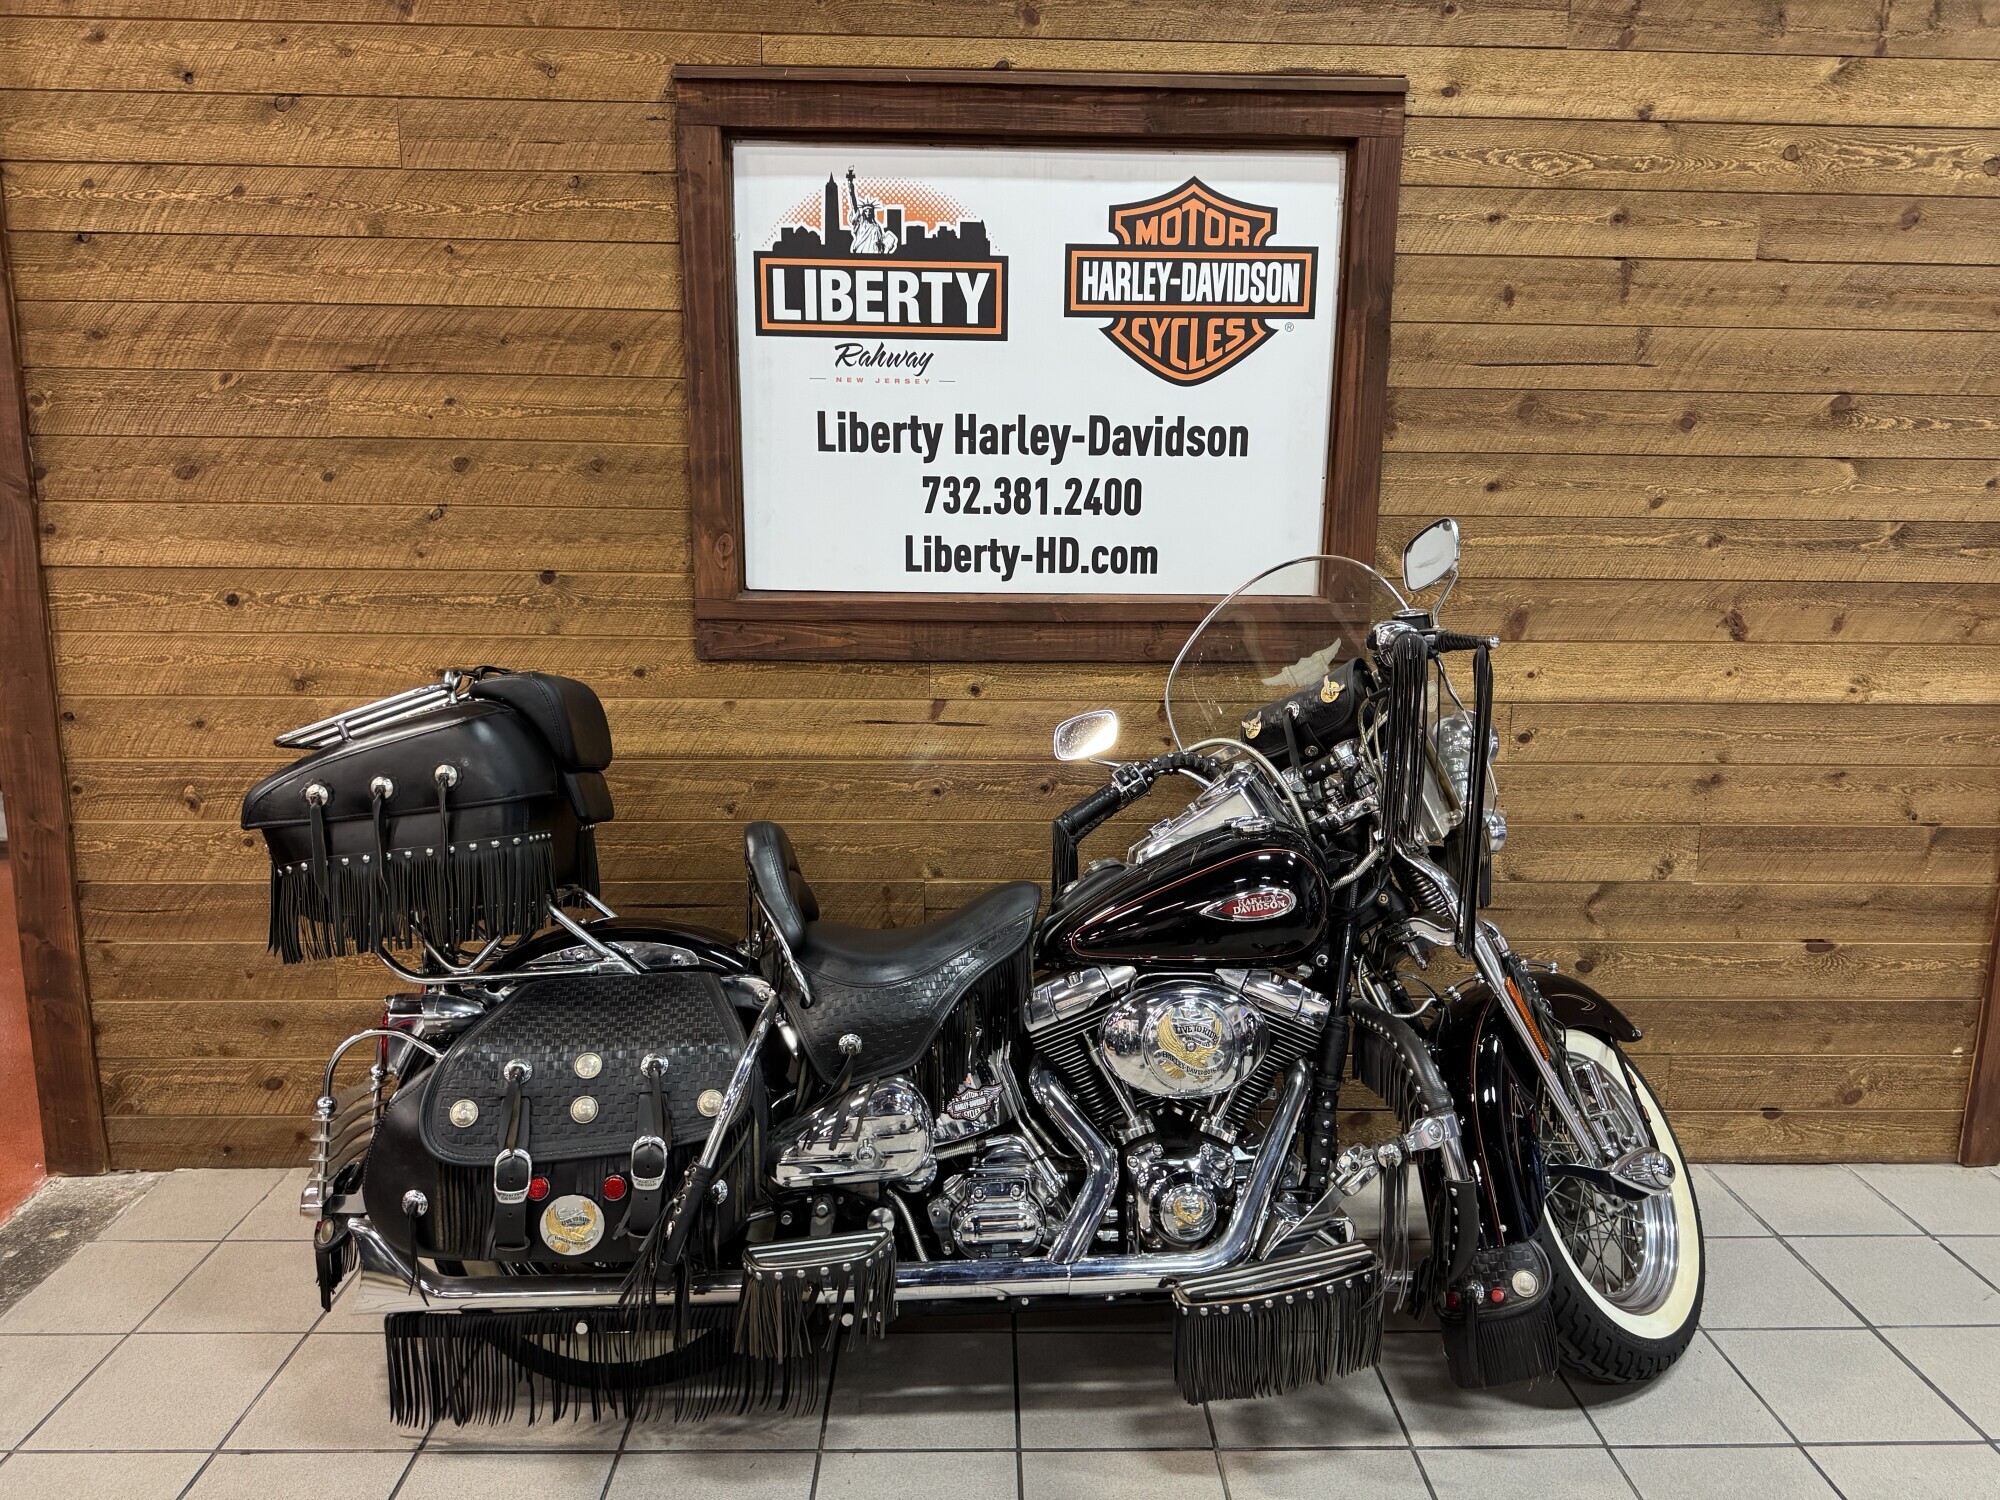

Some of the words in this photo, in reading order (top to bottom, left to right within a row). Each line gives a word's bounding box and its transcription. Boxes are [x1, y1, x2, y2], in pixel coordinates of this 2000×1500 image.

[1135, 198, 1250, 247] MOTOR
[772, 267, 991, 325] LIBERTY
[1081, 260, 1300, 304] HARLEY-DAVIDSON
[834, 341, 935, 377] Rahway
[1131, 317, 1246, 371] CYCLES
[835, 376, 865, 384] NEW
[875, 377, 932, 385] JERSEY
[816, 410, 944, 464] Liberty
[953, 413, 1249, 466] Harley-Davidson
[921, 475, 1143, 517] 732.381.2400
[904, 534, 1159, 582] Liberty-HD.com
[1174, 1025, 1193, 1035] LIVE
[1193, 1025, 1203, 1033] TO
